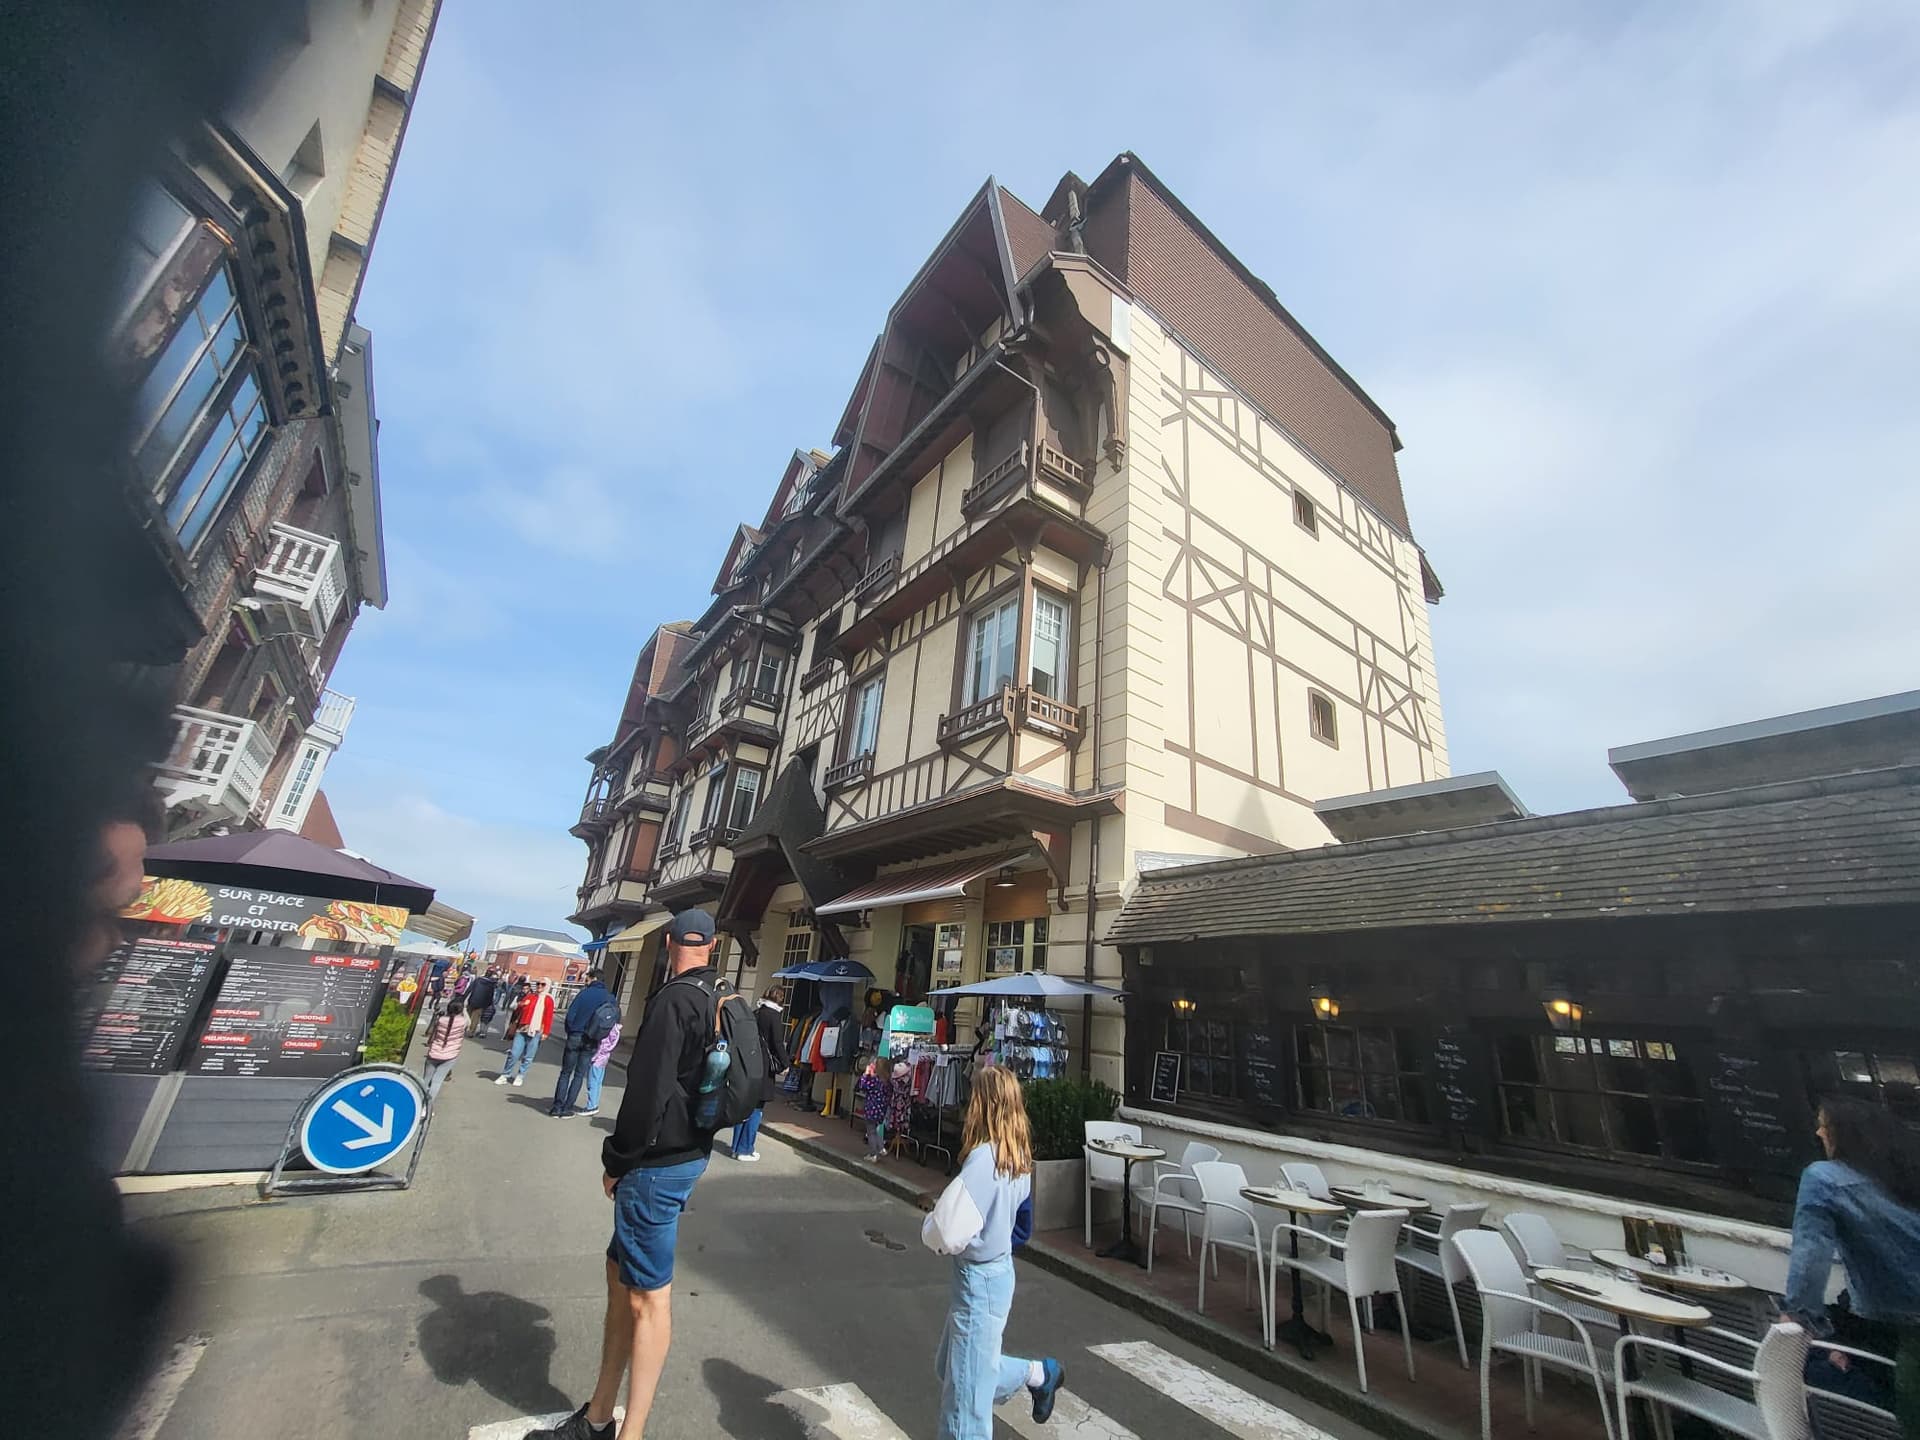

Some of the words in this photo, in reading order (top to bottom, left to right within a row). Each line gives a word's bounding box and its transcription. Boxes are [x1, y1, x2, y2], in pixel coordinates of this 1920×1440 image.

[218, 888, 253, 902] SUR
[257, 893, 305, 908] PLACE
[247, 904, 268, 916] ET
[200, 911, 214, 924] À
[219, 915, 299, 932] EMPORTER
